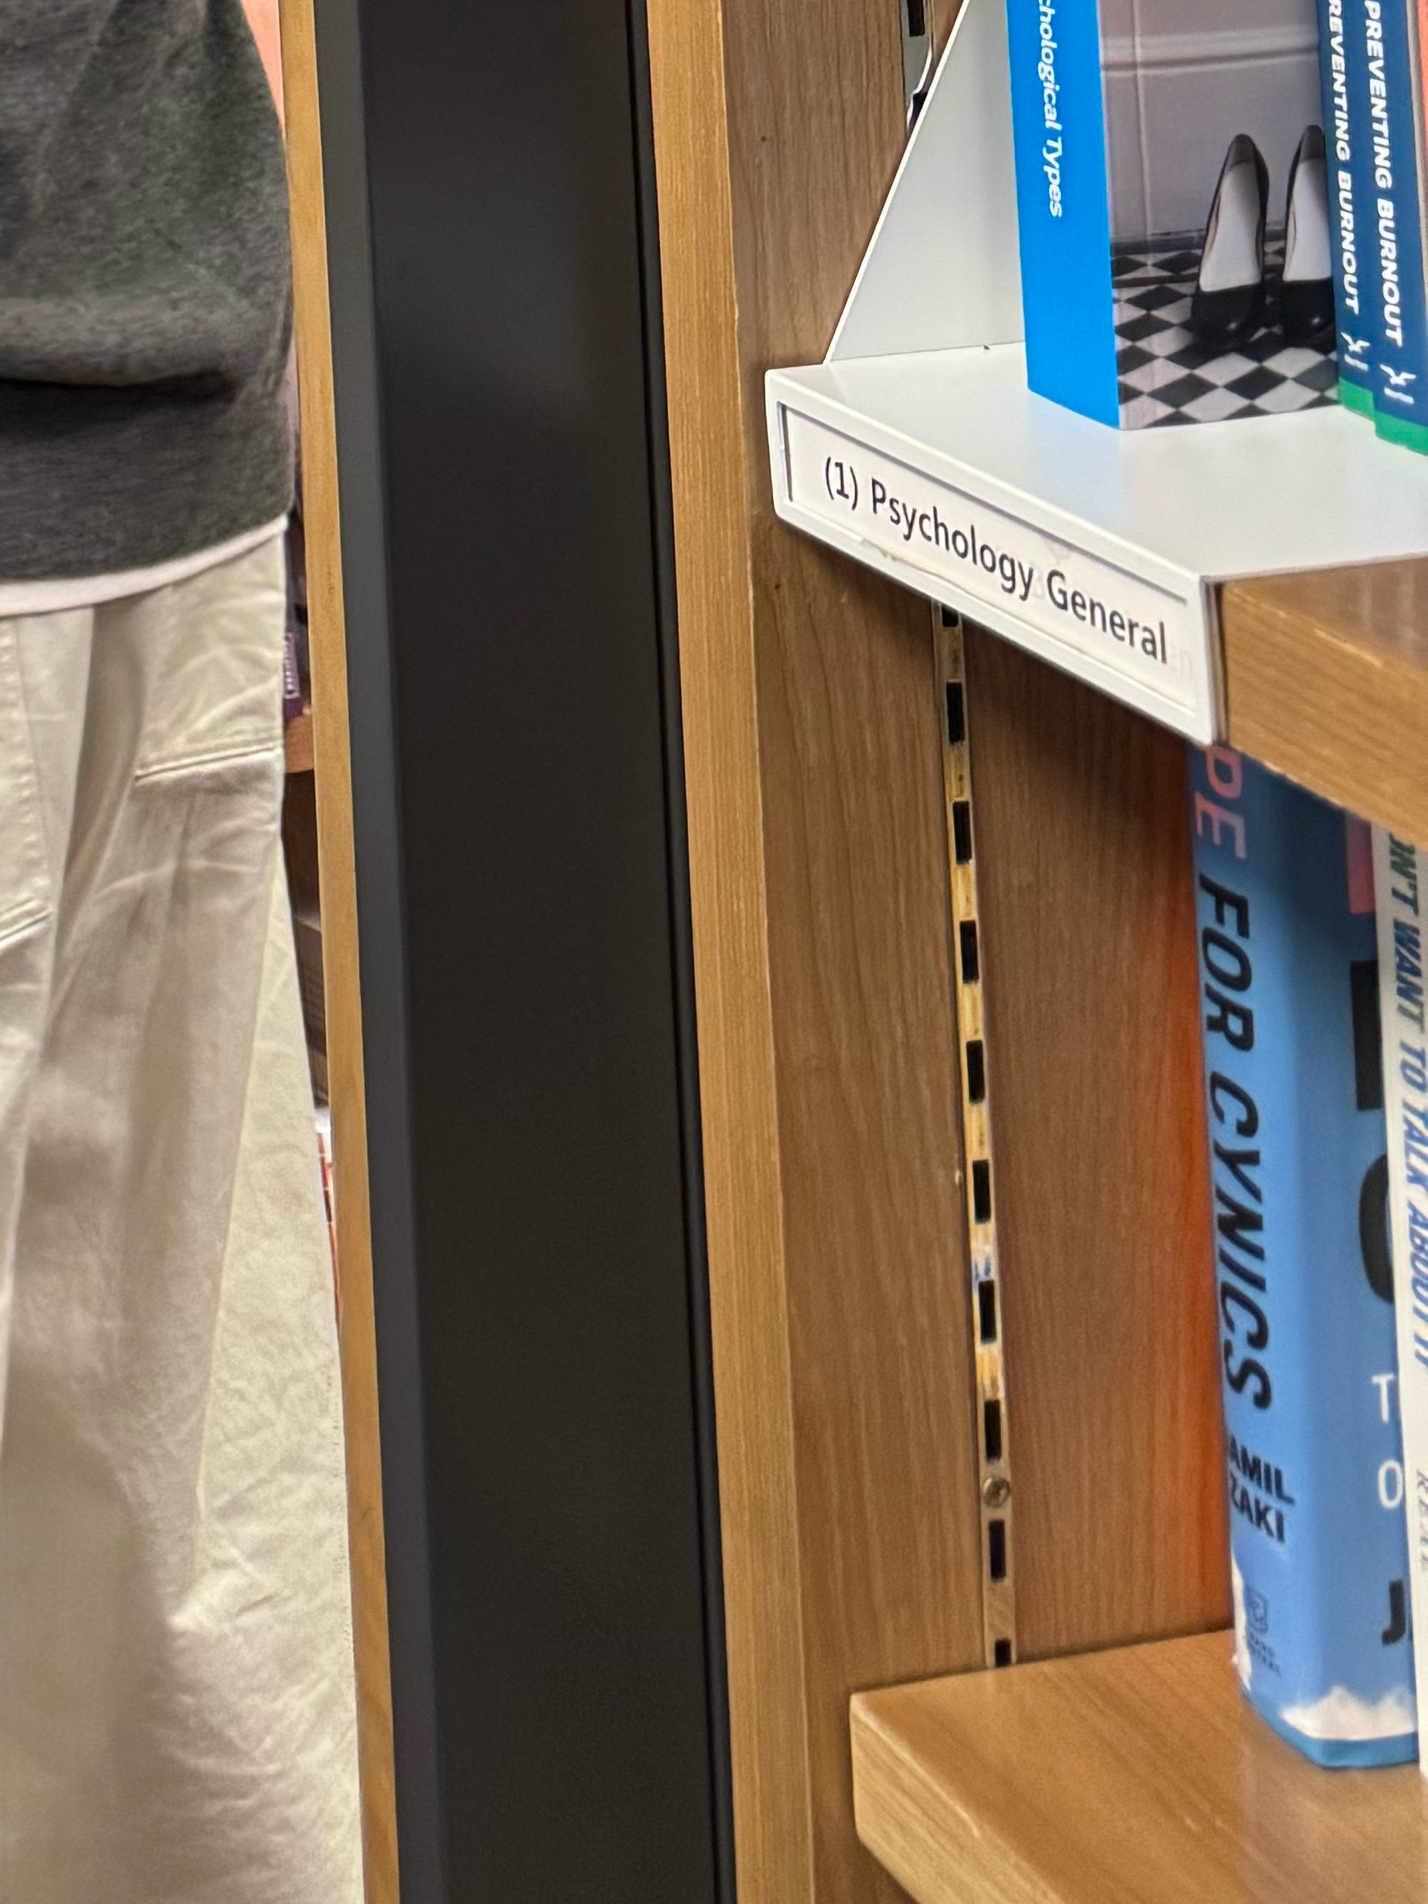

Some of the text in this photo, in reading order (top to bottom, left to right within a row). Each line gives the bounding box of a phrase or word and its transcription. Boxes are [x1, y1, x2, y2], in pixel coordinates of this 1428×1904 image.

[1043, 112, 1066, 219] Types
[1364, 1, 1396, 191] PREVENTING
[1374, 196, 1406, 348] BURNOUT
[824, 454, 1171, 666] (1) Psychology General
[1194, 745, 1273, 1411] DE FOR CYNICS
